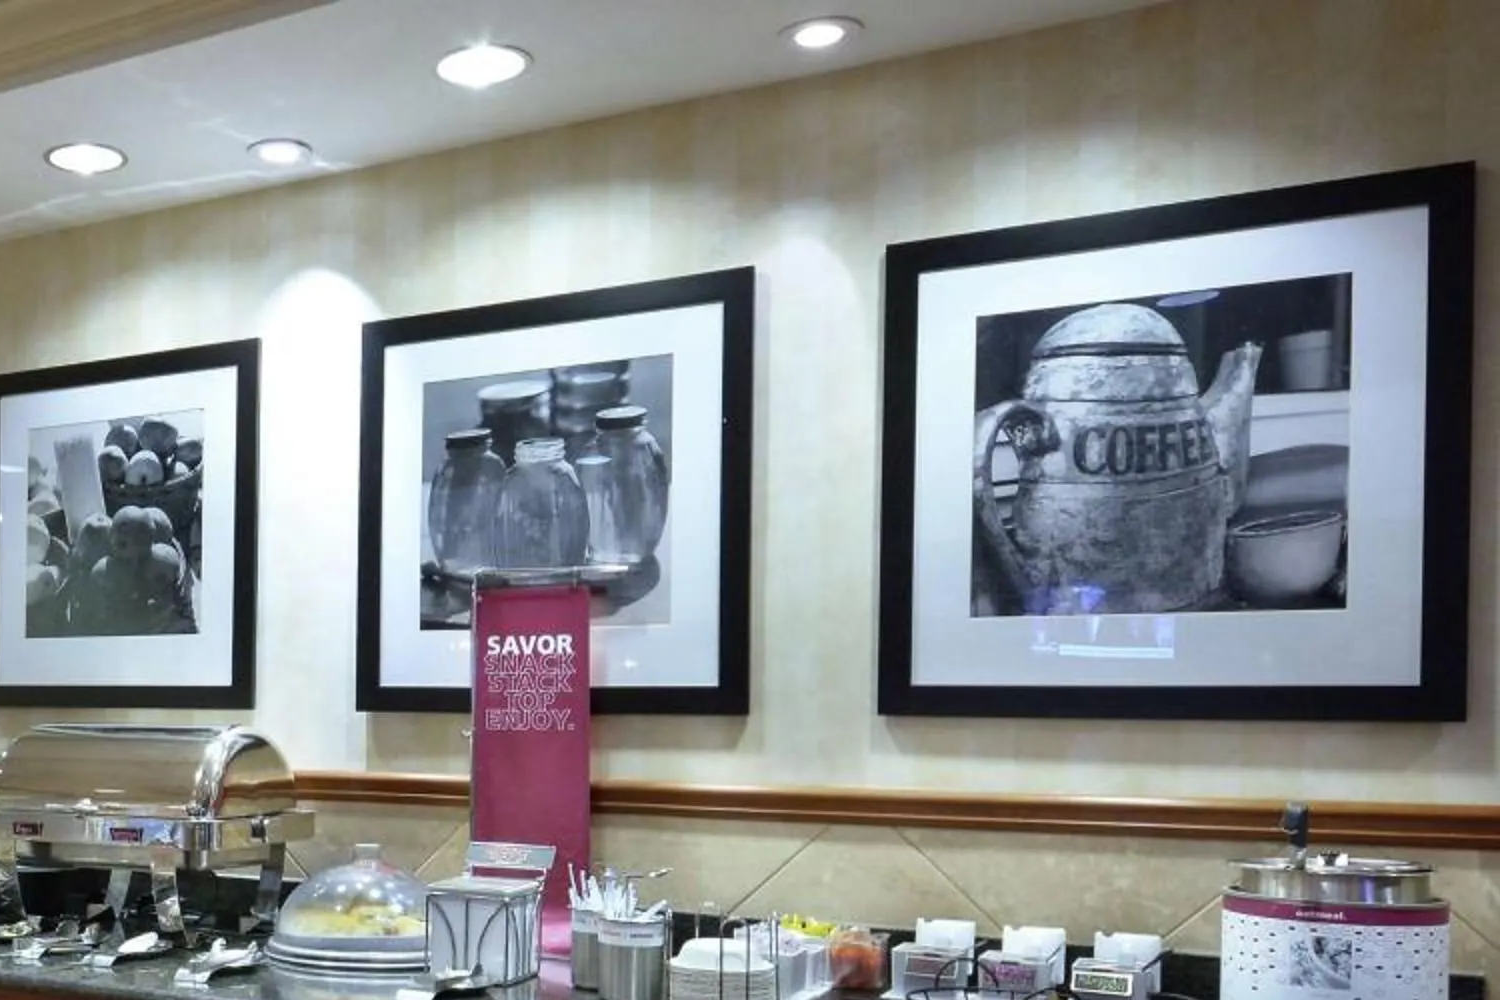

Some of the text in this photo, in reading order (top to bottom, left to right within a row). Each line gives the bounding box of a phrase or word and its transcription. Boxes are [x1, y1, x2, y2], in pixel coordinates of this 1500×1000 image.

[1073, 420, 1216, 475] COFFEE
[487, 634, 574, 656] SAVOR
[484, 653, 576, 674] SNACK
[487, 671, 573, 693] STACK
[504, 690, 556, 712] TOP
